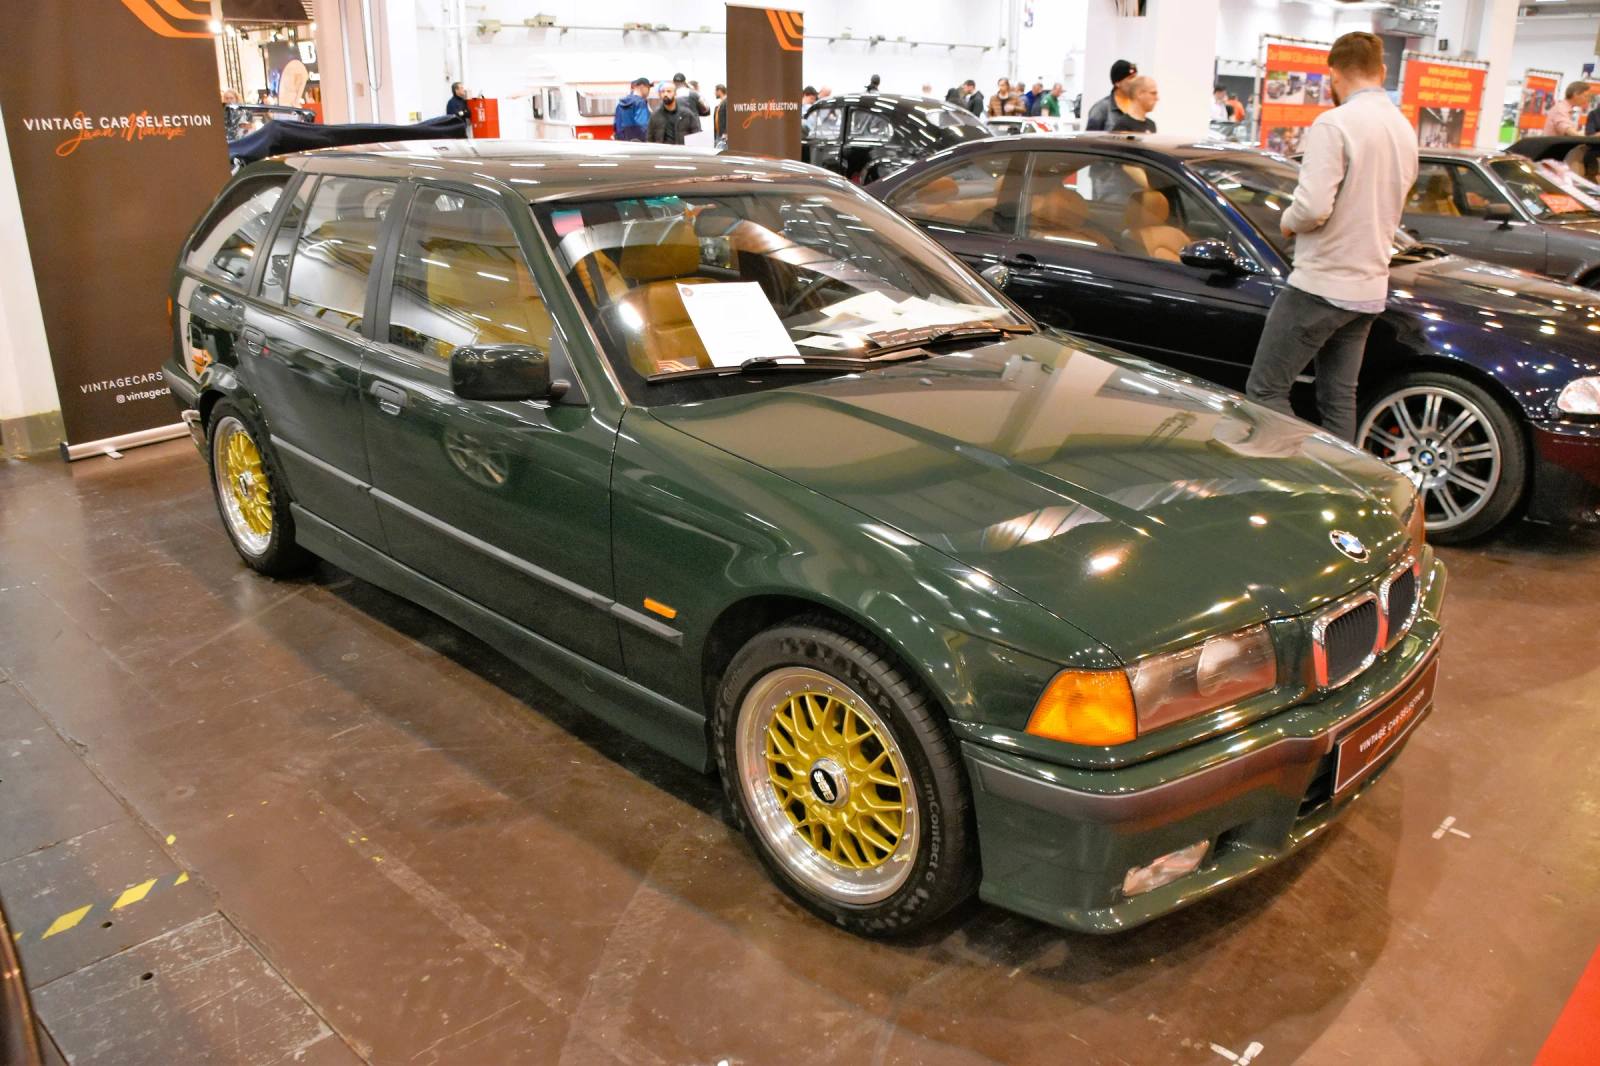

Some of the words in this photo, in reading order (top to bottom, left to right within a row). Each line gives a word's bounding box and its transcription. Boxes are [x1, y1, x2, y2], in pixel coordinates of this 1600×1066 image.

[733, 103, 757, 112] VINTAGE
[757, 103, 768, 111] CAR
[769, 102, 798, 111] SELECTION
[23, 117, 93, 131] VINTAGE
[100, 116, 130, 129] CAR
[136, 115, 212, 128] SELECTION
[80, 371, 163, 394] VINTAGECARS
[1359, 723, 1387, 753] VINTAGE
